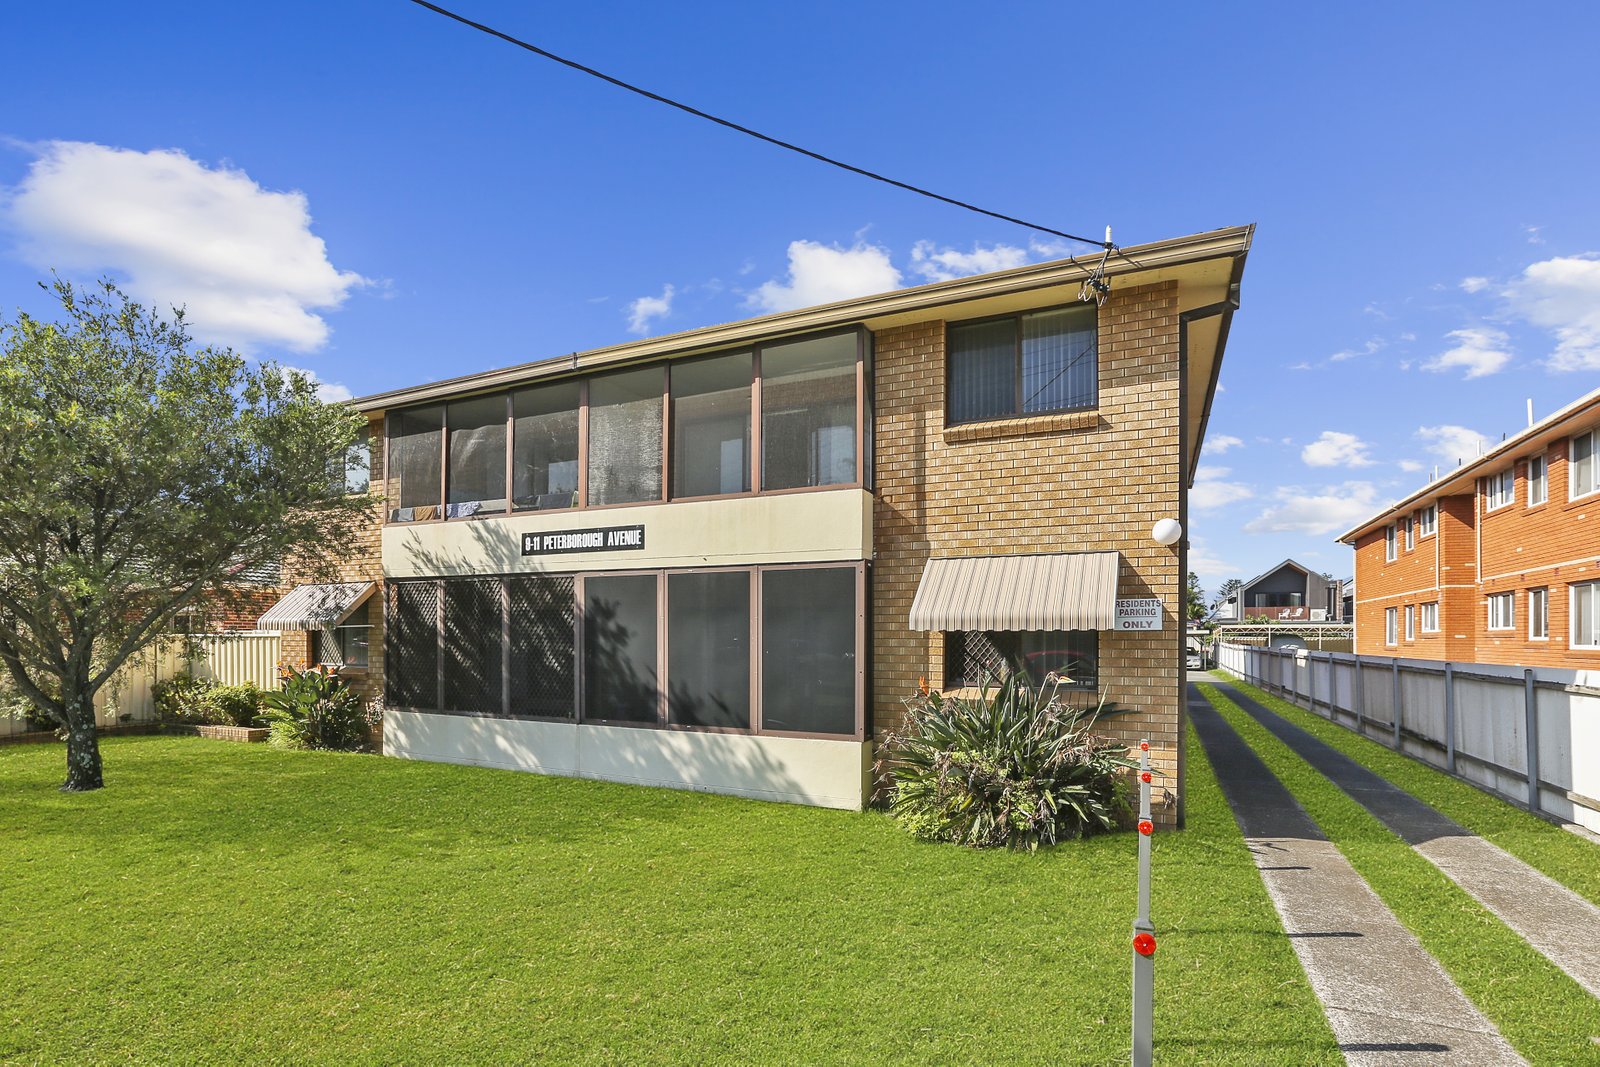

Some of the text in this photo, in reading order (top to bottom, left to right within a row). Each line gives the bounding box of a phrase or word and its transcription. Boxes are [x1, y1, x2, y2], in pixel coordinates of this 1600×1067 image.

[543, 532, 604, 550] PETERBOROUGH
[607, 529, 642, 546] AVENUE
[1115, 600, 1161, 608] RESIDENTS
[1119, 608, 1156, 616] PARKING
[1122, 621, 1153, 629] ONLY
